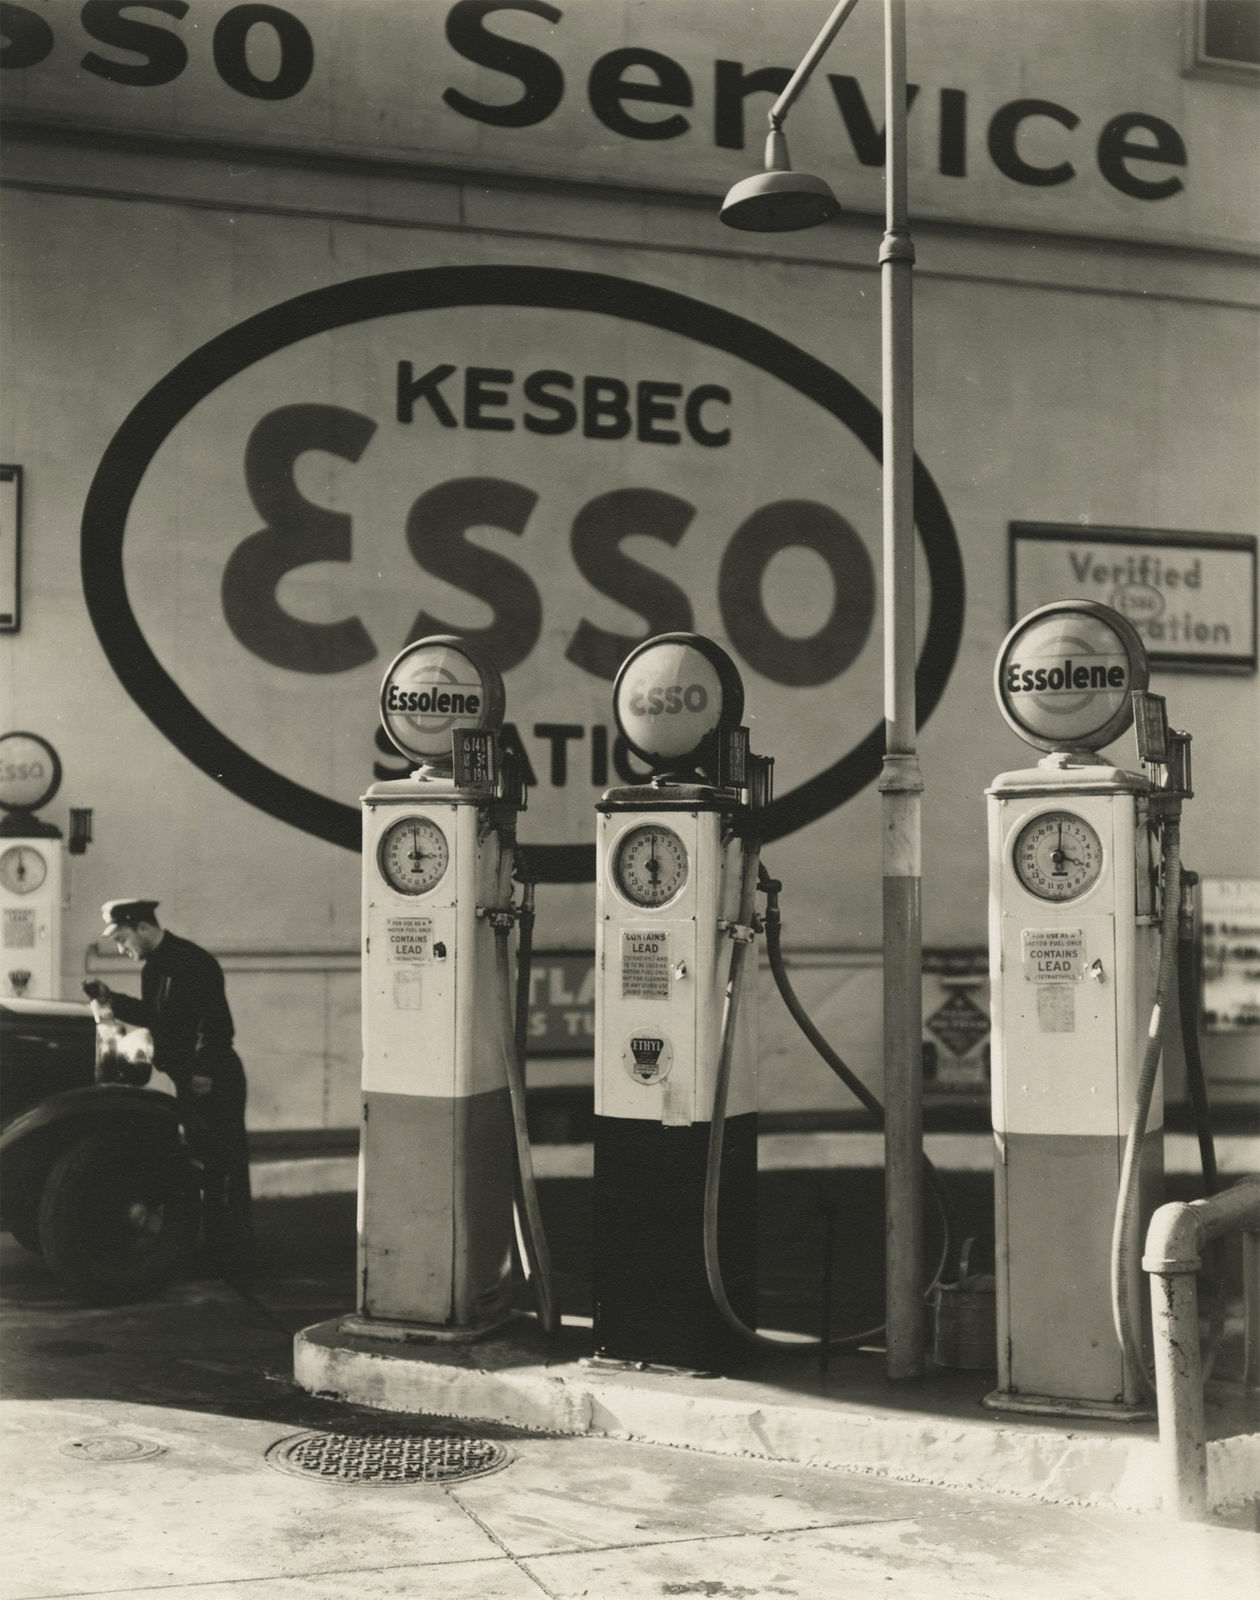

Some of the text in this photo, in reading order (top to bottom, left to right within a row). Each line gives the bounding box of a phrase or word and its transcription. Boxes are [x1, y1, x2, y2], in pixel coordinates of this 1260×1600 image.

[441, 0, 1188, 201] Service
[396, 360, 732, 447] KESBEC
[1069, 551, 1202, 589] Verified
[1007, 660, 1125, 692] Essolene
[388, 685, 480, 714] Essolene
[626, 933, 666, 941] CONTAINS
[396, 945, 422, 954] LEAD
[632, 944, 659, 953] LEAD
[1030, 950, 1078, 958] CONTAINS
[1038, 961, 1071, 971] LEAD
